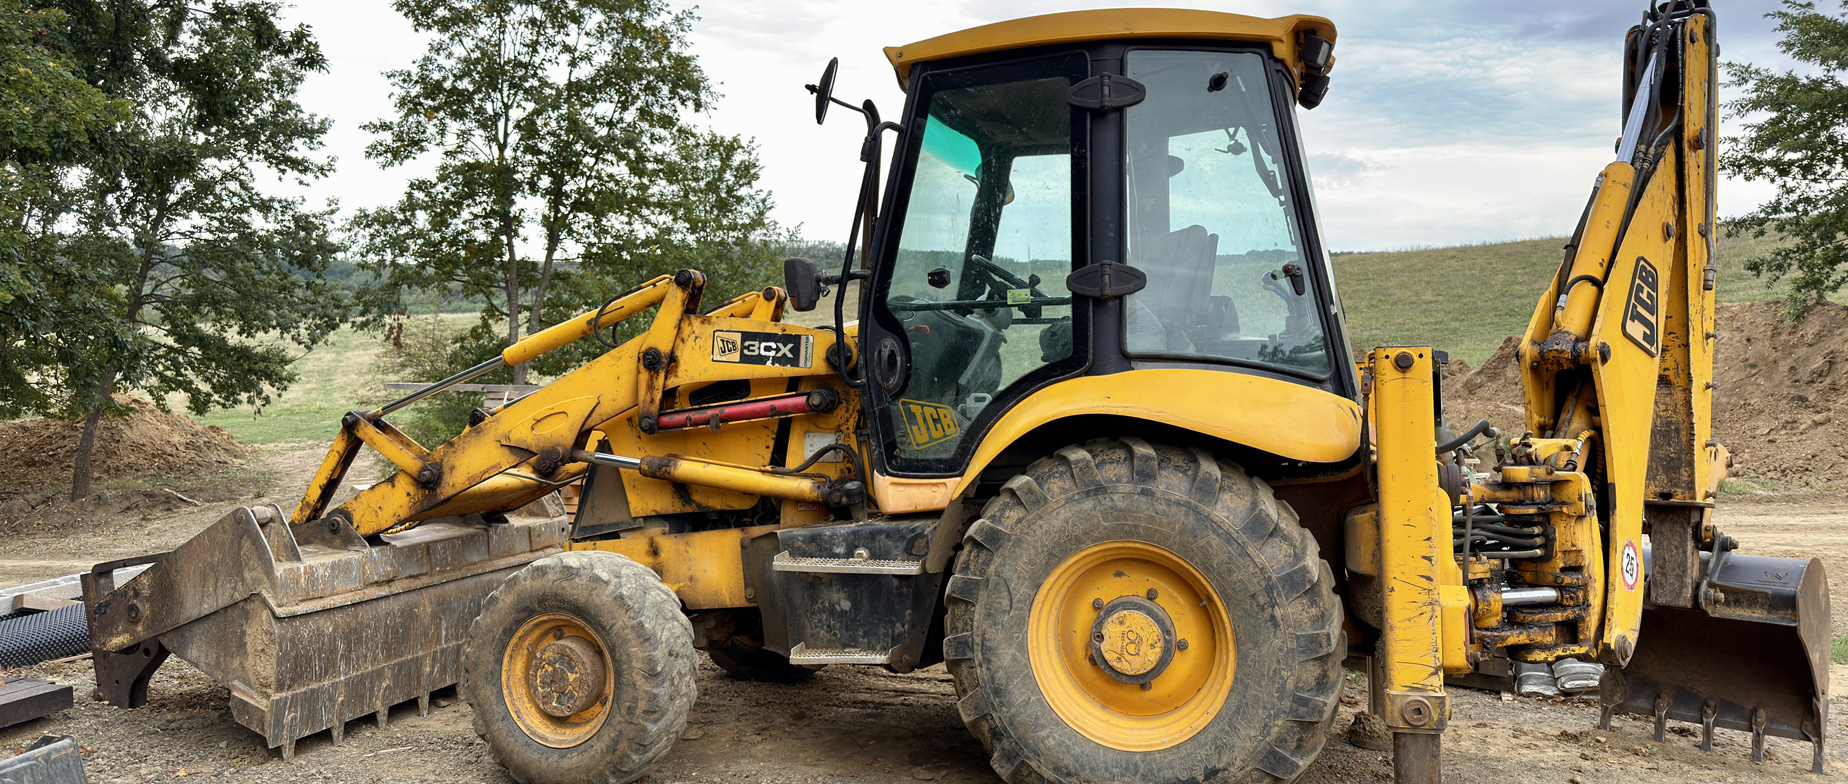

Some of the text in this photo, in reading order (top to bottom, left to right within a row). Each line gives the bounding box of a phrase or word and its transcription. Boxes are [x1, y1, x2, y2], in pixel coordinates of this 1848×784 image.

[1629, 264, 1656, 348] JCB
[720, 338, 794, 358] JCB 3CX
[909, 404, 956, 444] JCB
